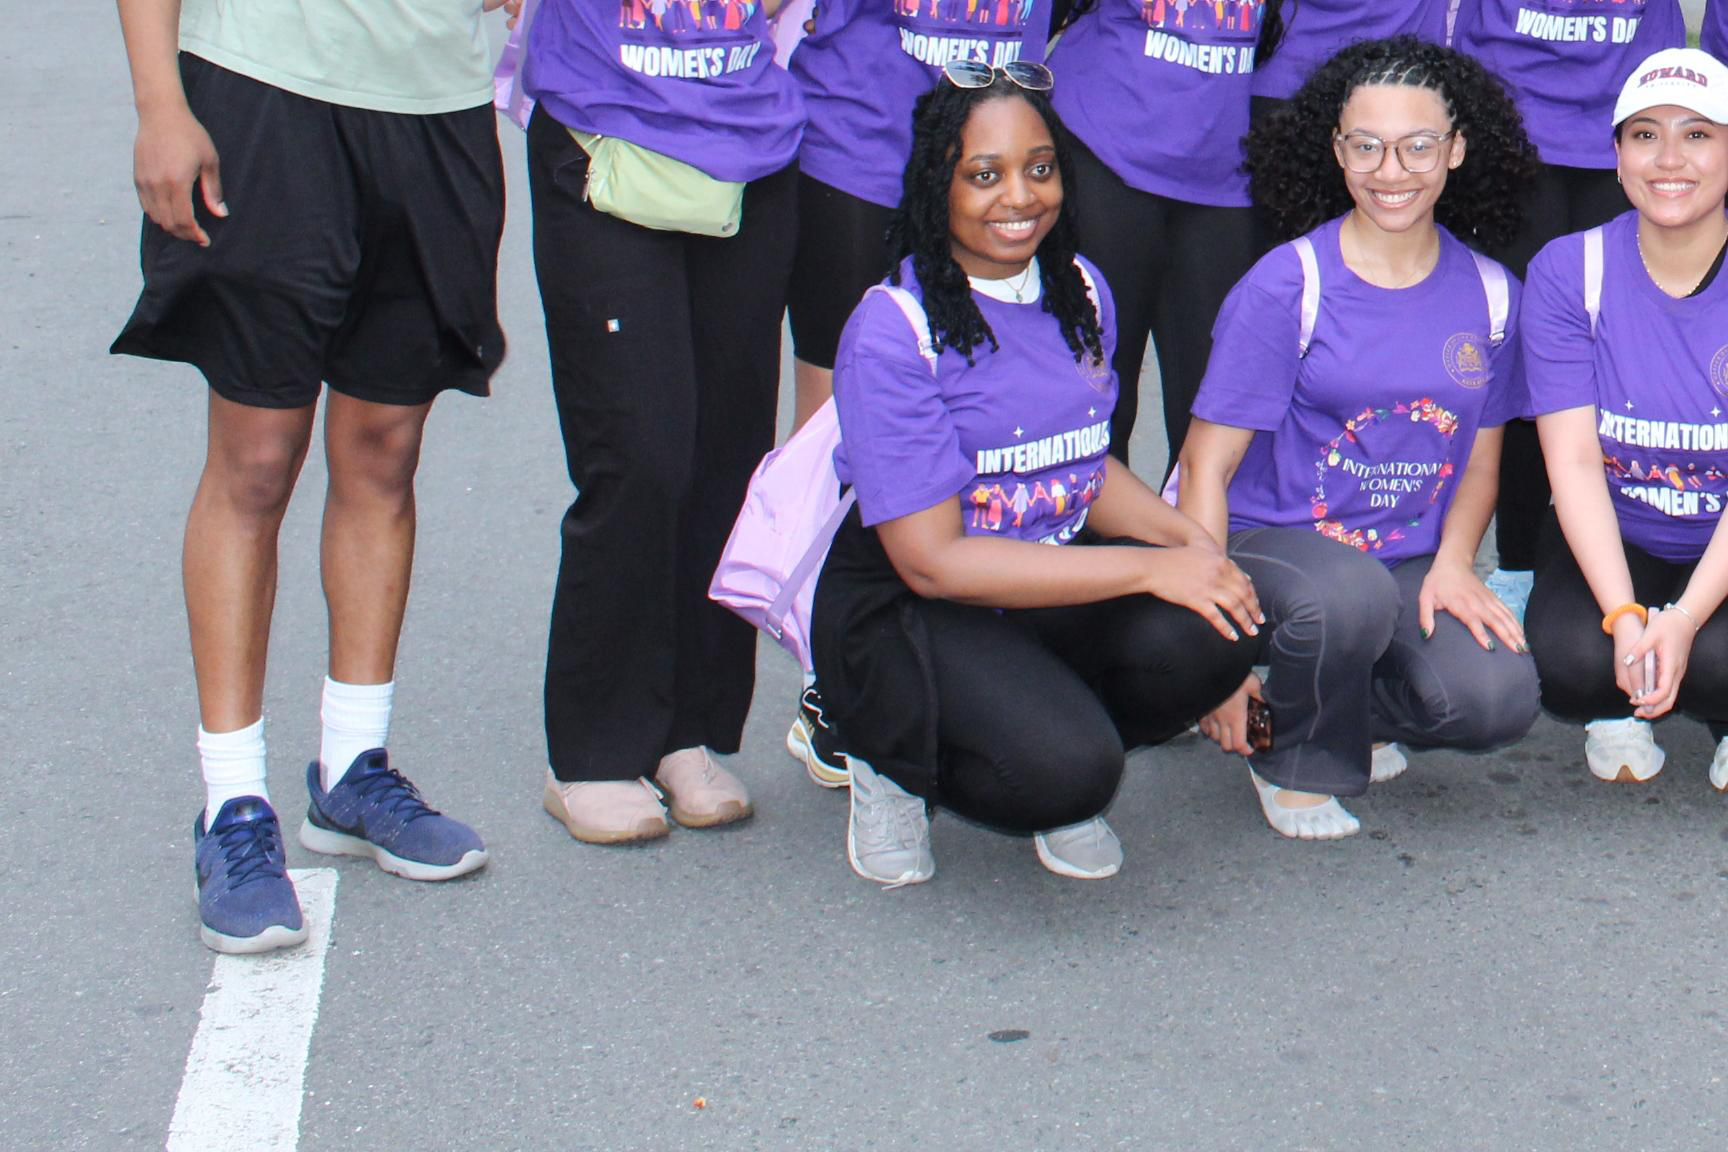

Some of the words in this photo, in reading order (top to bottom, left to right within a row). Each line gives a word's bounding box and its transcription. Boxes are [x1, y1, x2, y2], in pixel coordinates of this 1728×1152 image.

[1515, 8, 1607, 42] WOMEN'S
[1612, 16, 1642, 44] DA
[726, 41, 761, 73] DAY
[1144, 30, 1236, 74] WOMEN'S
[1637, 66, 1707, 88] HOWARD
[1370, 493, 1400, 508] DAY
